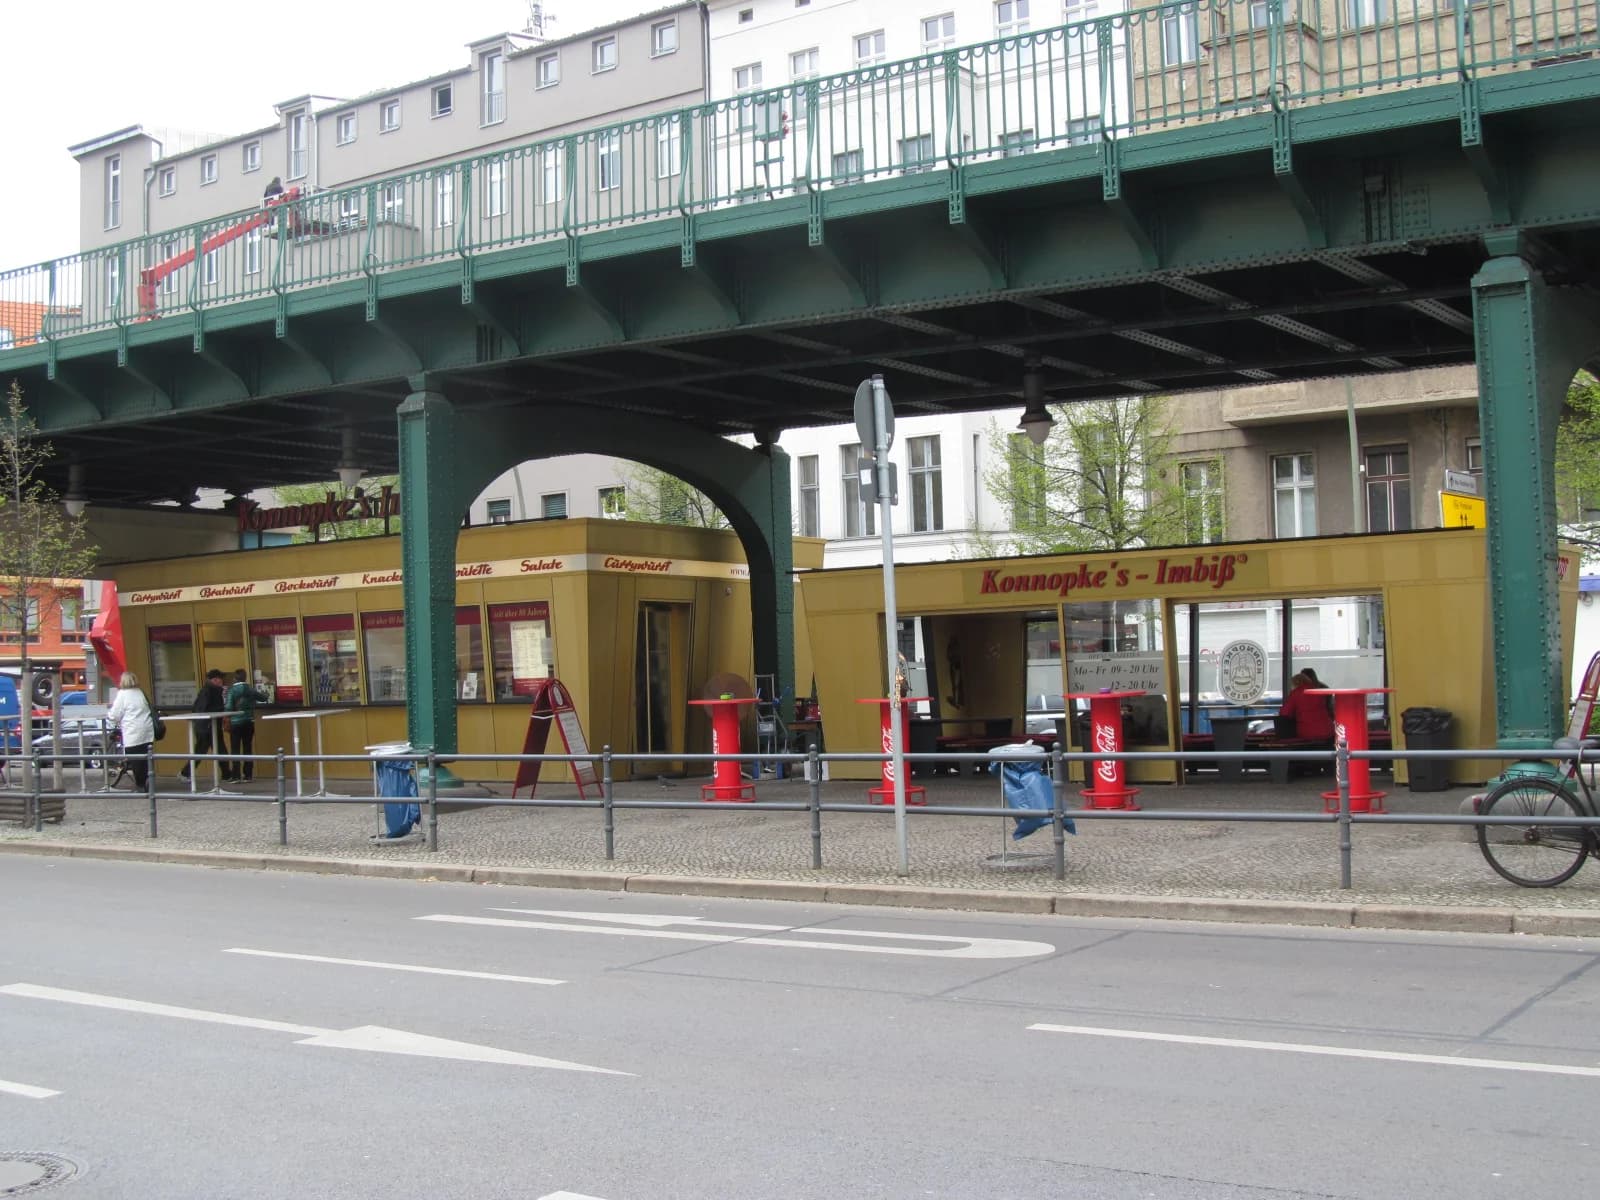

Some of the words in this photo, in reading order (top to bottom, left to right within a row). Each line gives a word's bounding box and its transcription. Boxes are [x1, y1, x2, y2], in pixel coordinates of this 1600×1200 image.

[520, 559, 563, 573] Salate
[979, 561, 1130, 597] Konnopke's
[1129, 664, 1140, 674] 20
[1142, 663, 1160, 673] Uhr
[1128, 680, 1139, 689] 20
[1141, 679, 1159, 689] Uhr
